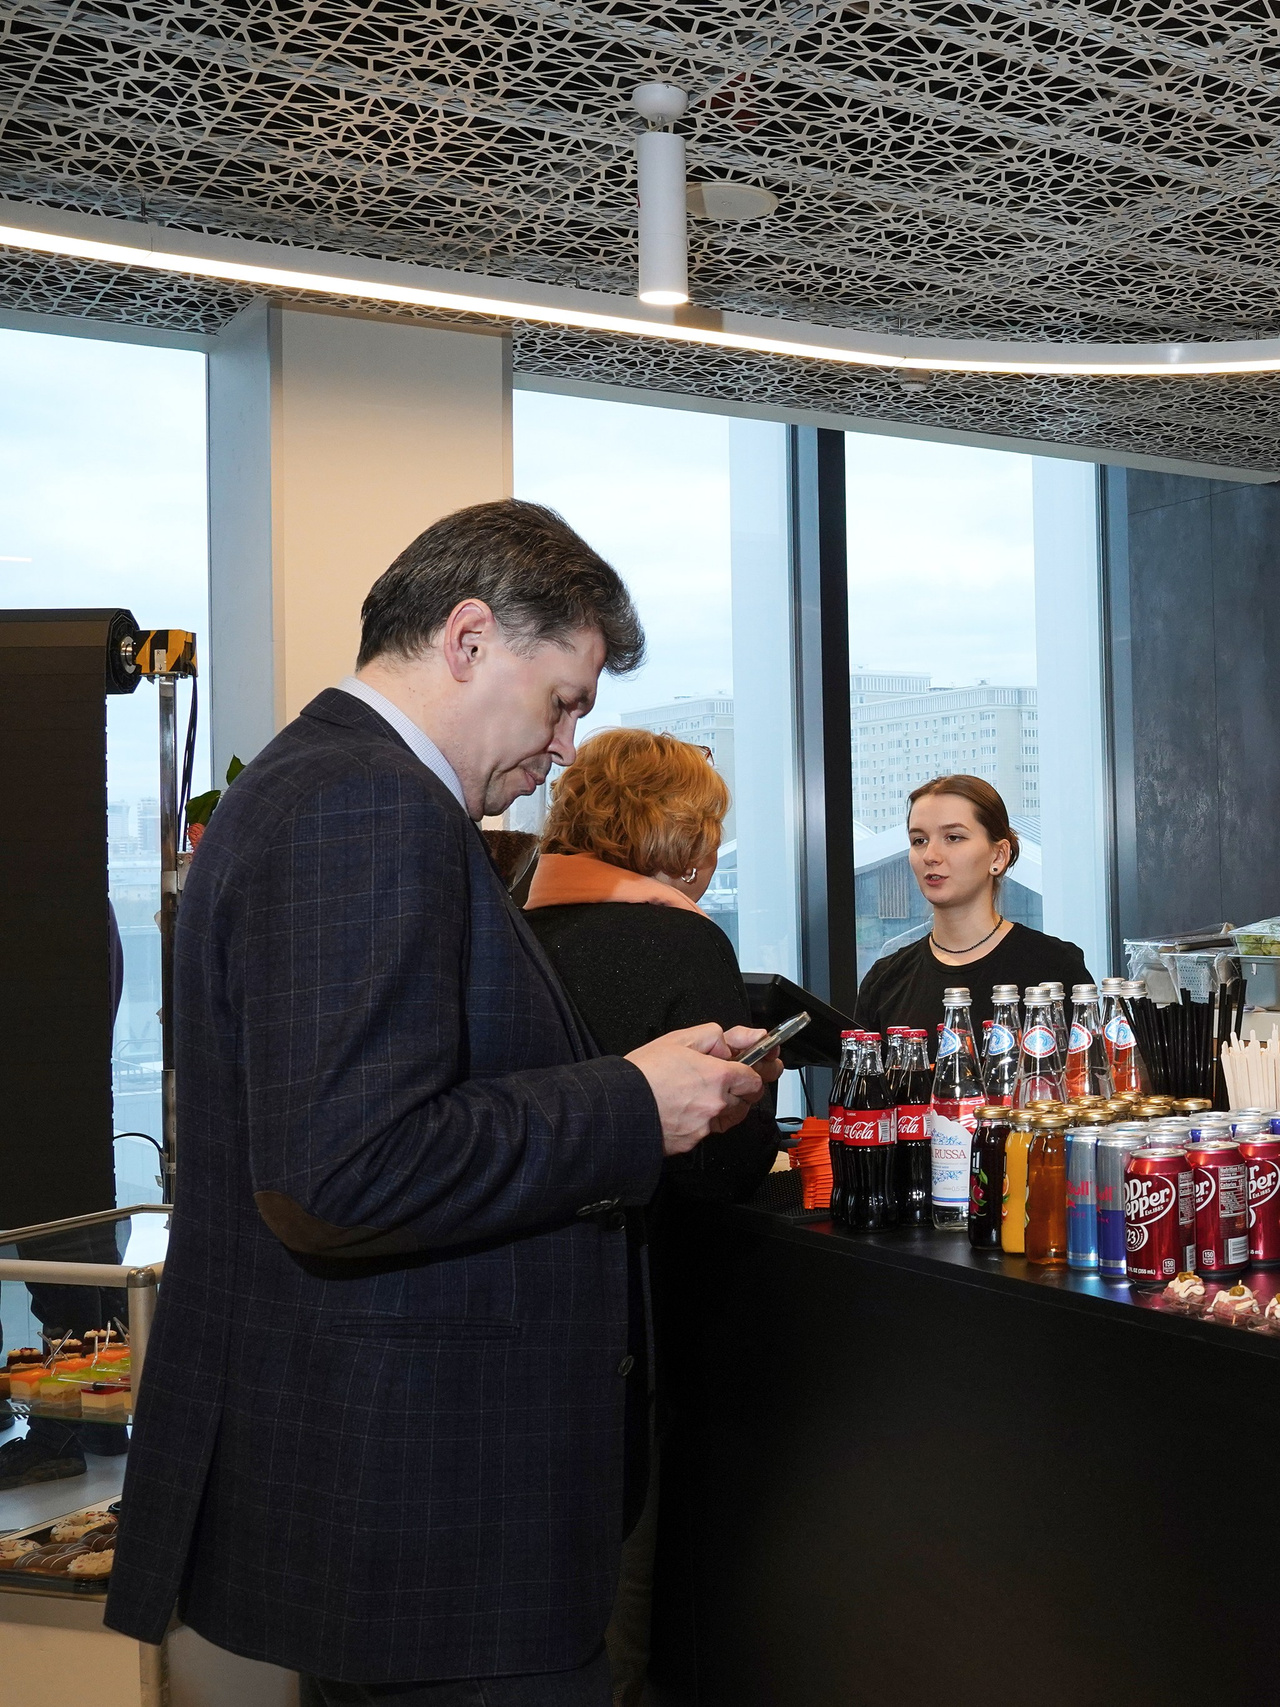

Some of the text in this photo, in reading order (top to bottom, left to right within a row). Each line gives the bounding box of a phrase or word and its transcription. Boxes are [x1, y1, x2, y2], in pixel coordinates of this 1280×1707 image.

[934, 1149, 967, 1159] RUSSA
[1249, 1165, 1260, 1180] r
[1129, 1179, 1153, 1201] Dr
[1126, 1229, 1137, 1244] 23
